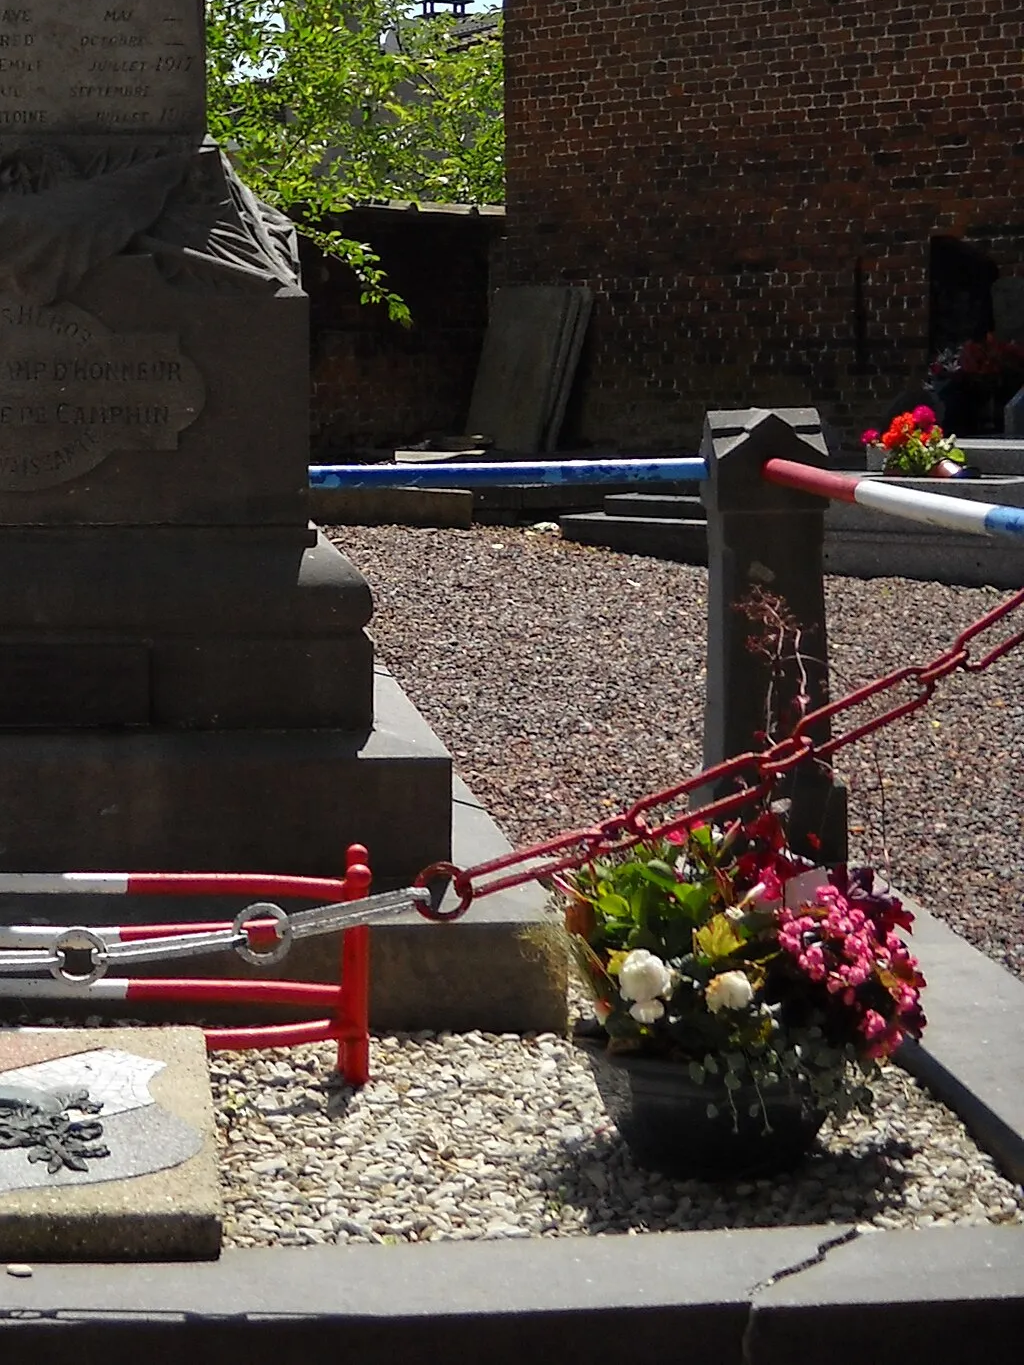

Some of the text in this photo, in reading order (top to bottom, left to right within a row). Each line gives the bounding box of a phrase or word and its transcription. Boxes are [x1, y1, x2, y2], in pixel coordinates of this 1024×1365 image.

[103, 10, 134, 22] MAI
[88, 60, 149, 72] JUILLET
[155, 55, 196, 72] 1917
[52, 360, 183, 382] D'HONNEUR
[20, 405, 48, 424] DE
[56, 402, 169, 425] CAMPHIN
